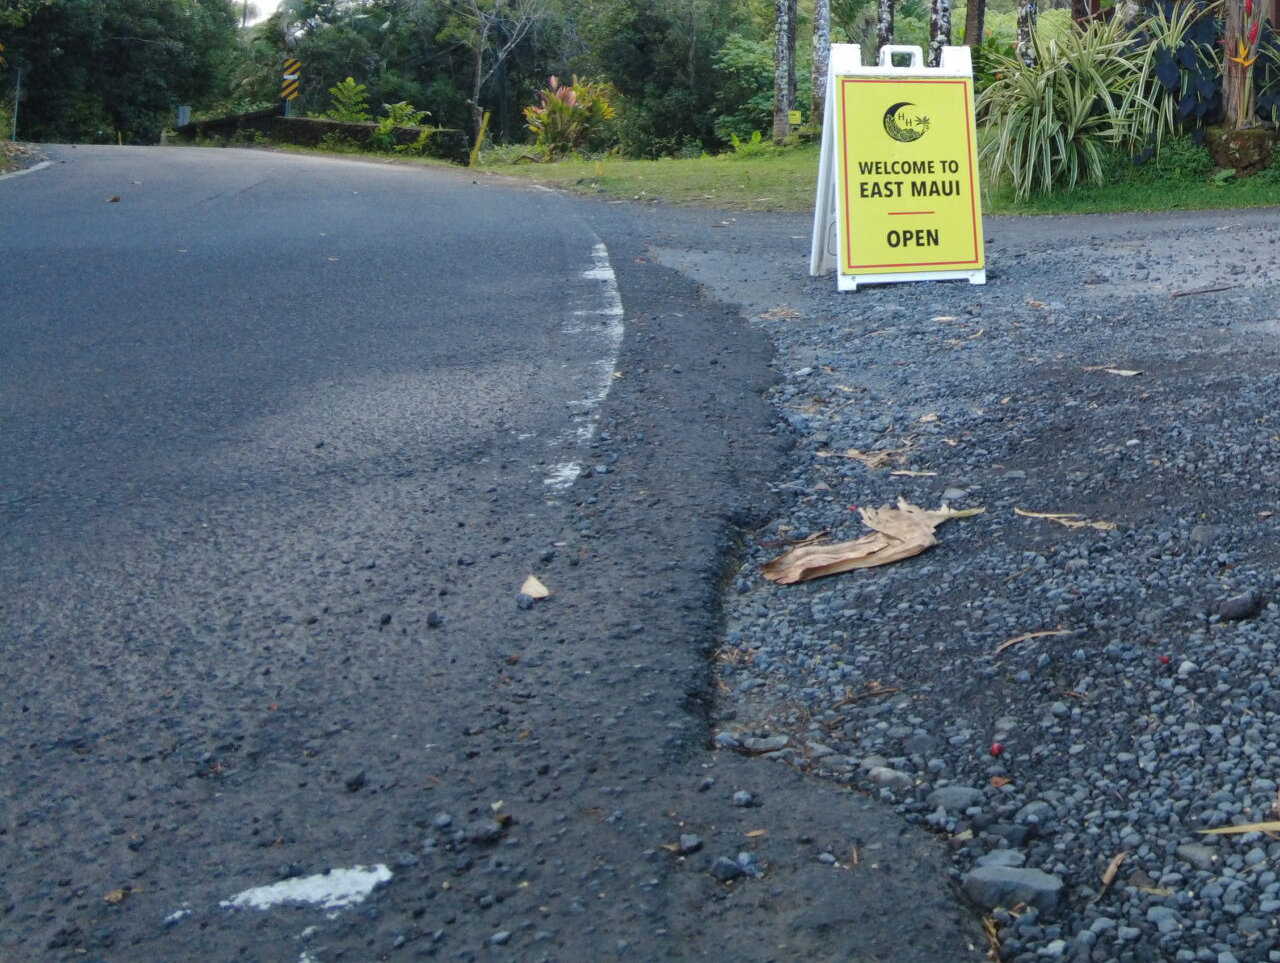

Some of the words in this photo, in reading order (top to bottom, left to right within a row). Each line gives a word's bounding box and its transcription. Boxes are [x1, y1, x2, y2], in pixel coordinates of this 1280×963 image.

[858, 161, 935, 175] WELCOME
[940, 160, 959, 174] TO
[860, 181, 904, 198] EAST
[911, 180, 961, 196] MAUI
[886, 229, 940, 248] OPEN
